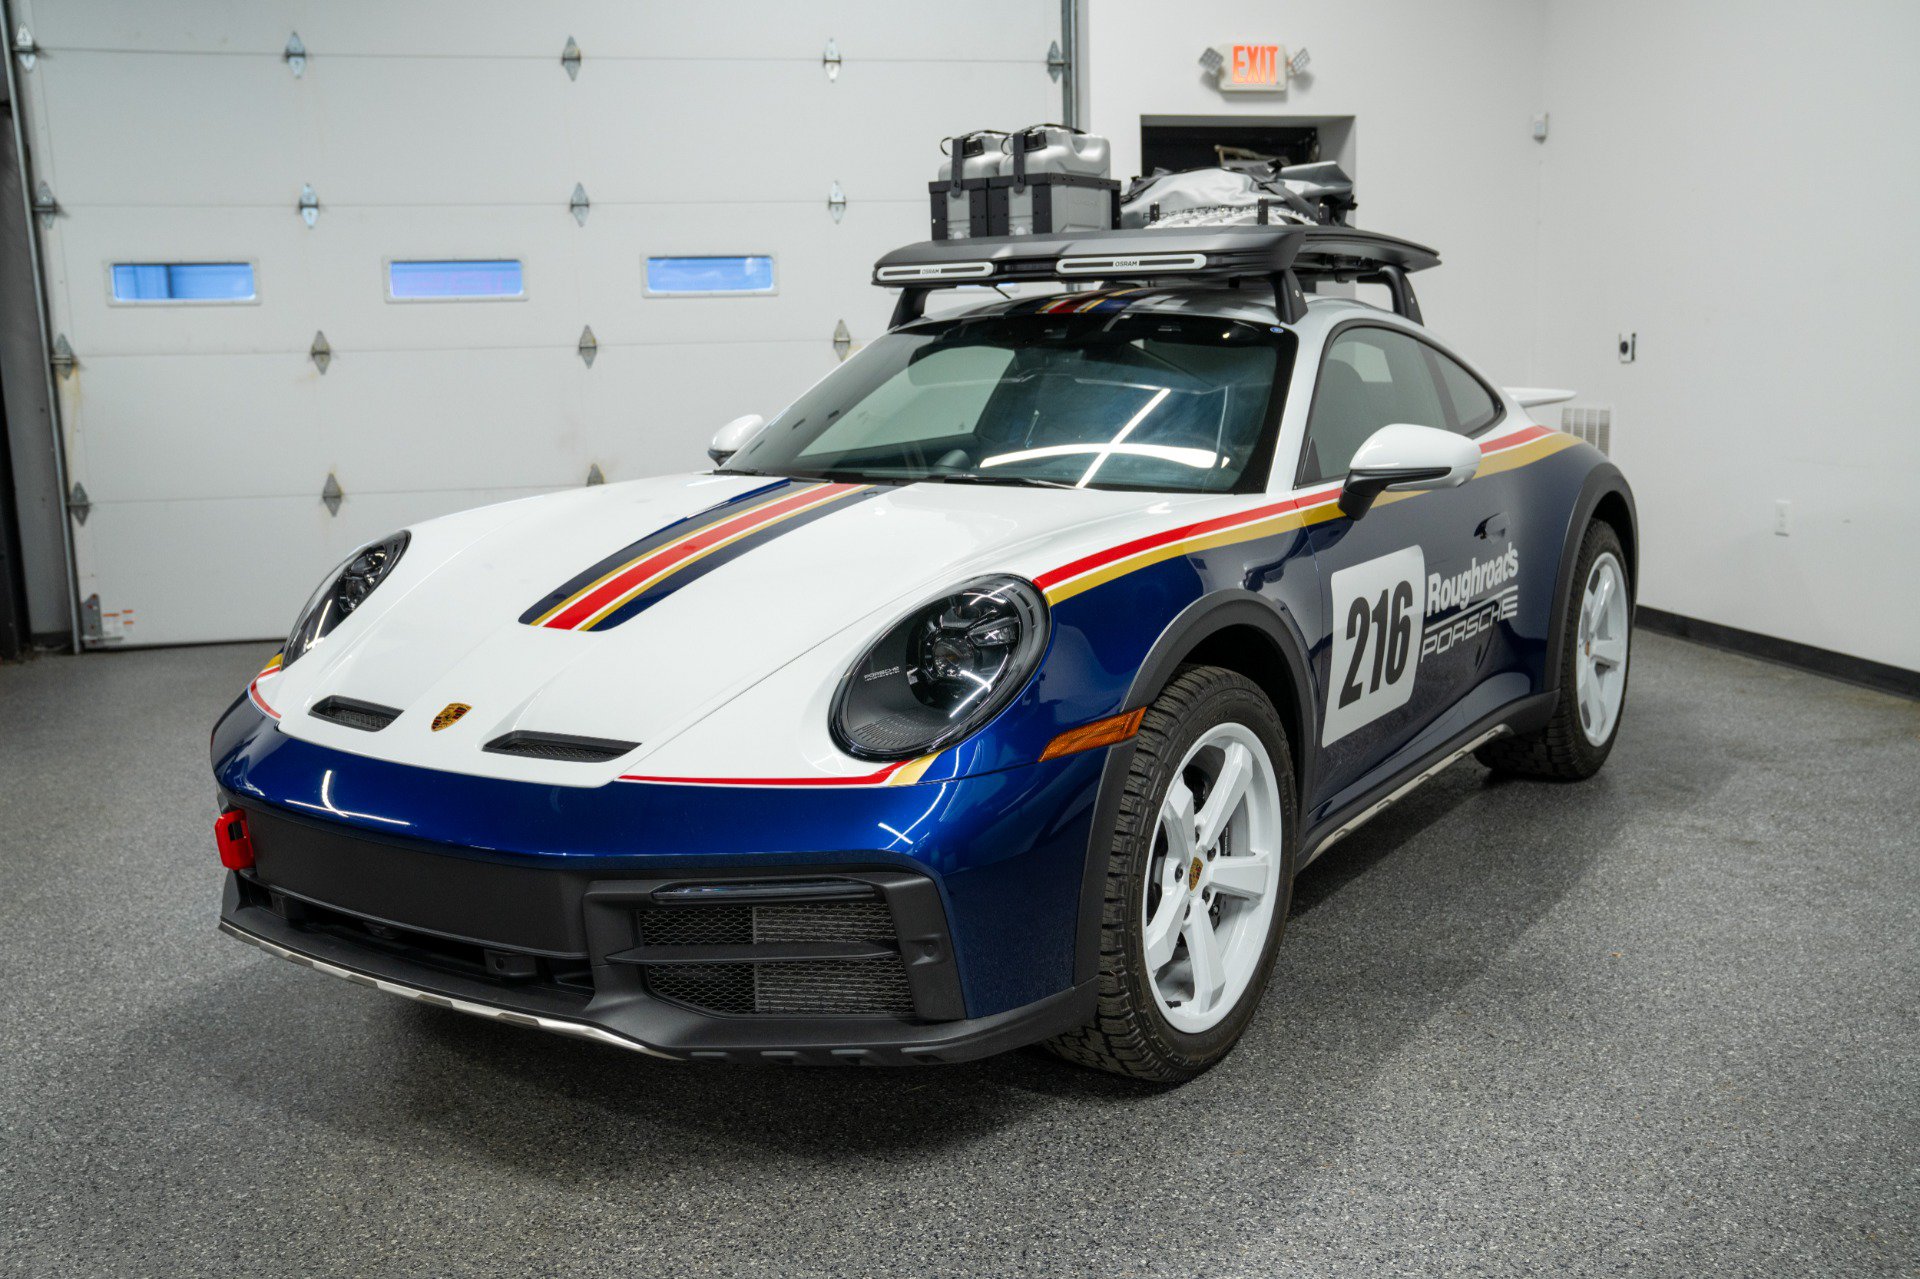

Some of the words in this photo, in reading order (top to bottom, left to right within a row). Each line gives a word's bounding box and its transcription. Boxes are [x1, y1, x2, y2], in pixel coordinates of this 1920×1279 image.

[1232, 45, 1279, 84] EXIT
[1427, 542, 1519, 617] Roughroads
[1339, 580, 1413, 710] 216
[1421, 595, 1518, 663] PORSCHE
